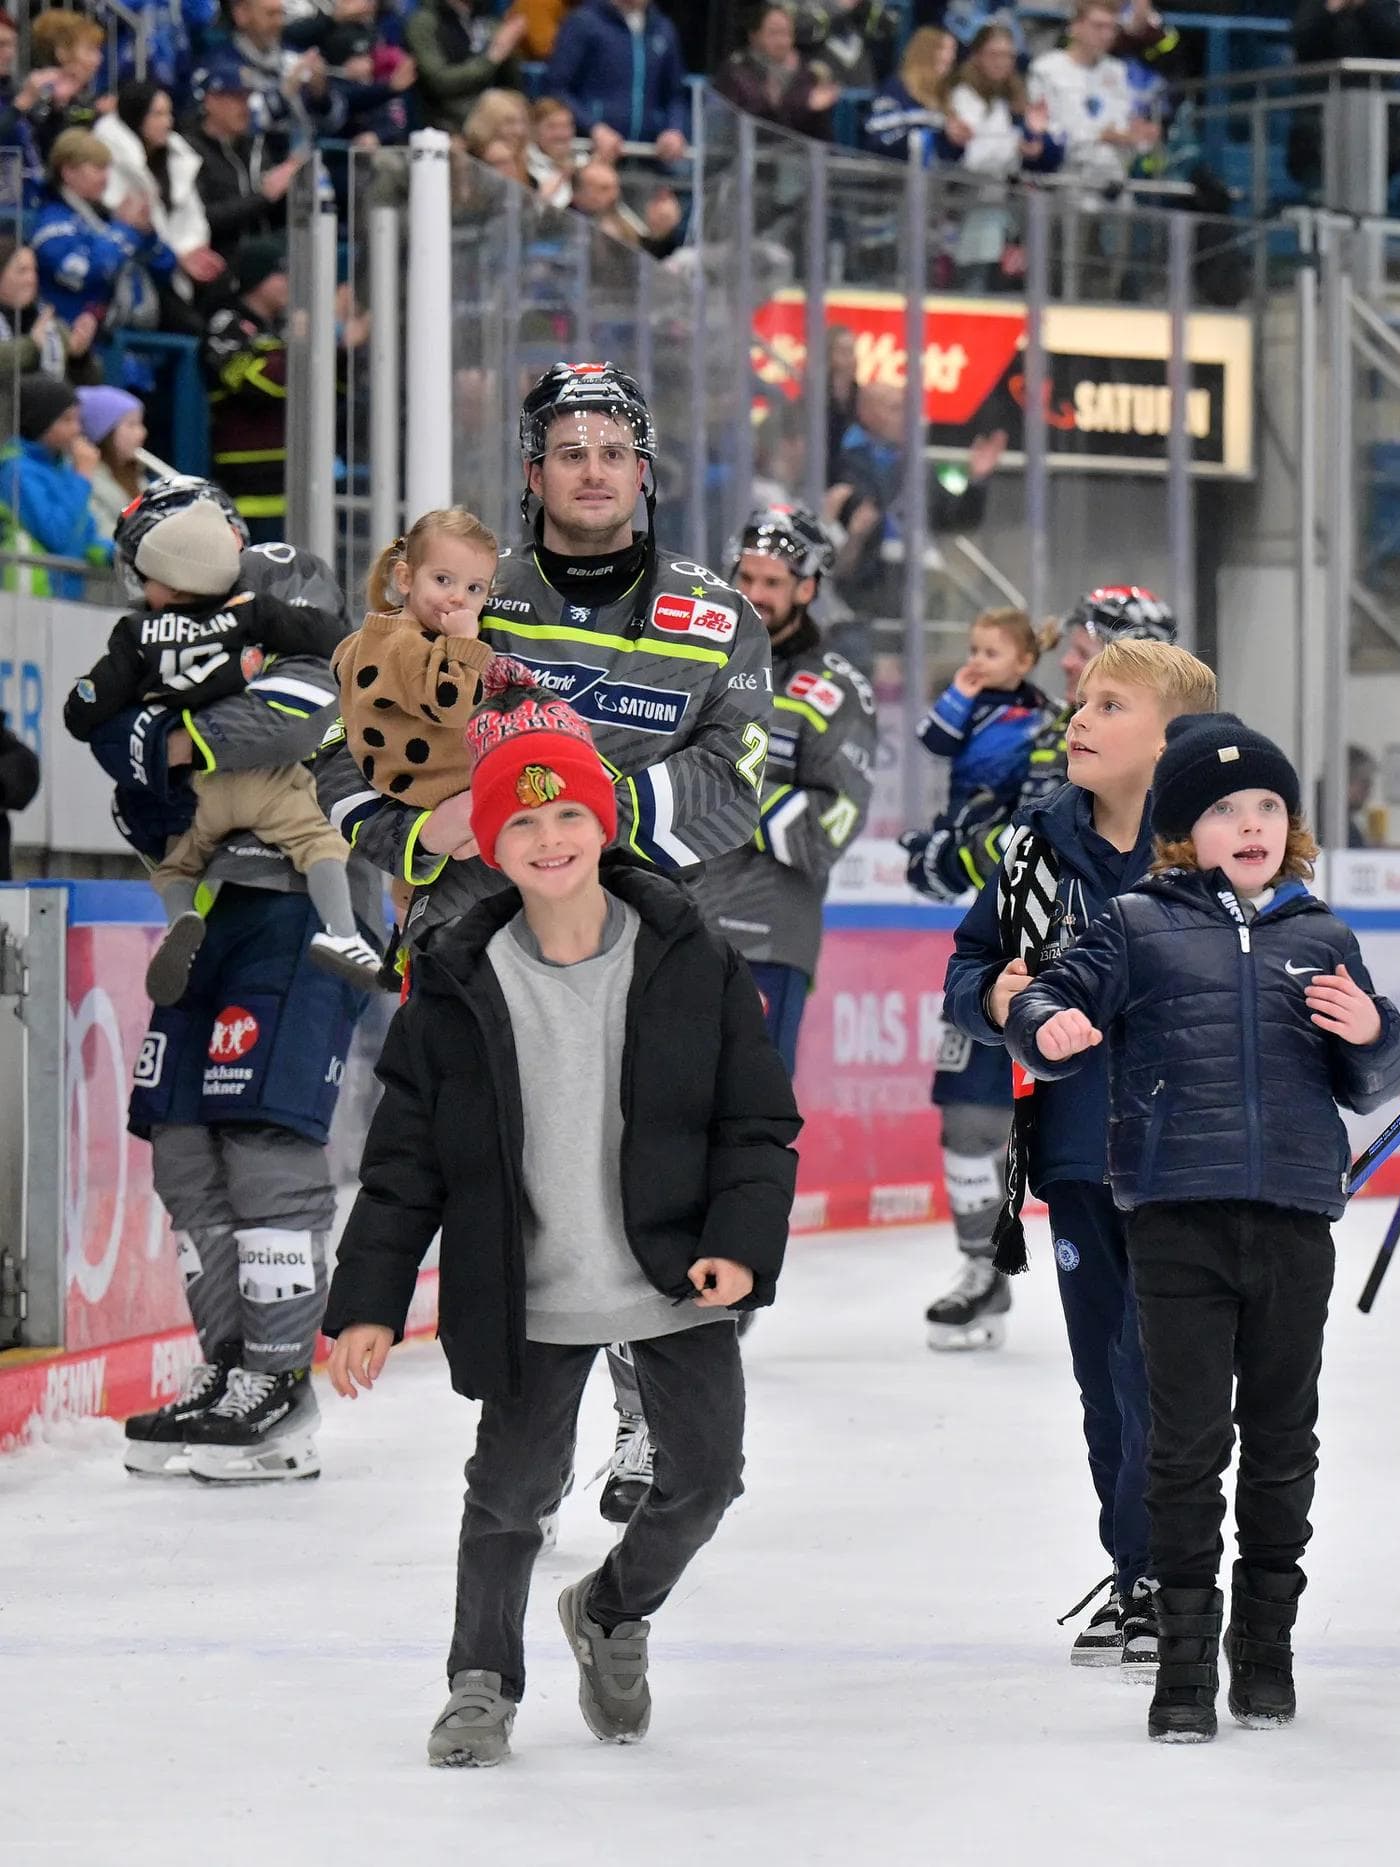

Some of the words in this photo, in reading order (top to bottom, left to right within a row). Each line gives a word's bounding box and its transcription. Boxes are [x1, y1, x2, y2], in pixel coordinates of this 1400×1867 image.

[1073, 379, 1212, 438] SATUN
[483, 595, 531, 614] ayern
[618, 696, 677, 723] SATURN
[832, 991, 908, 1066] DAS
